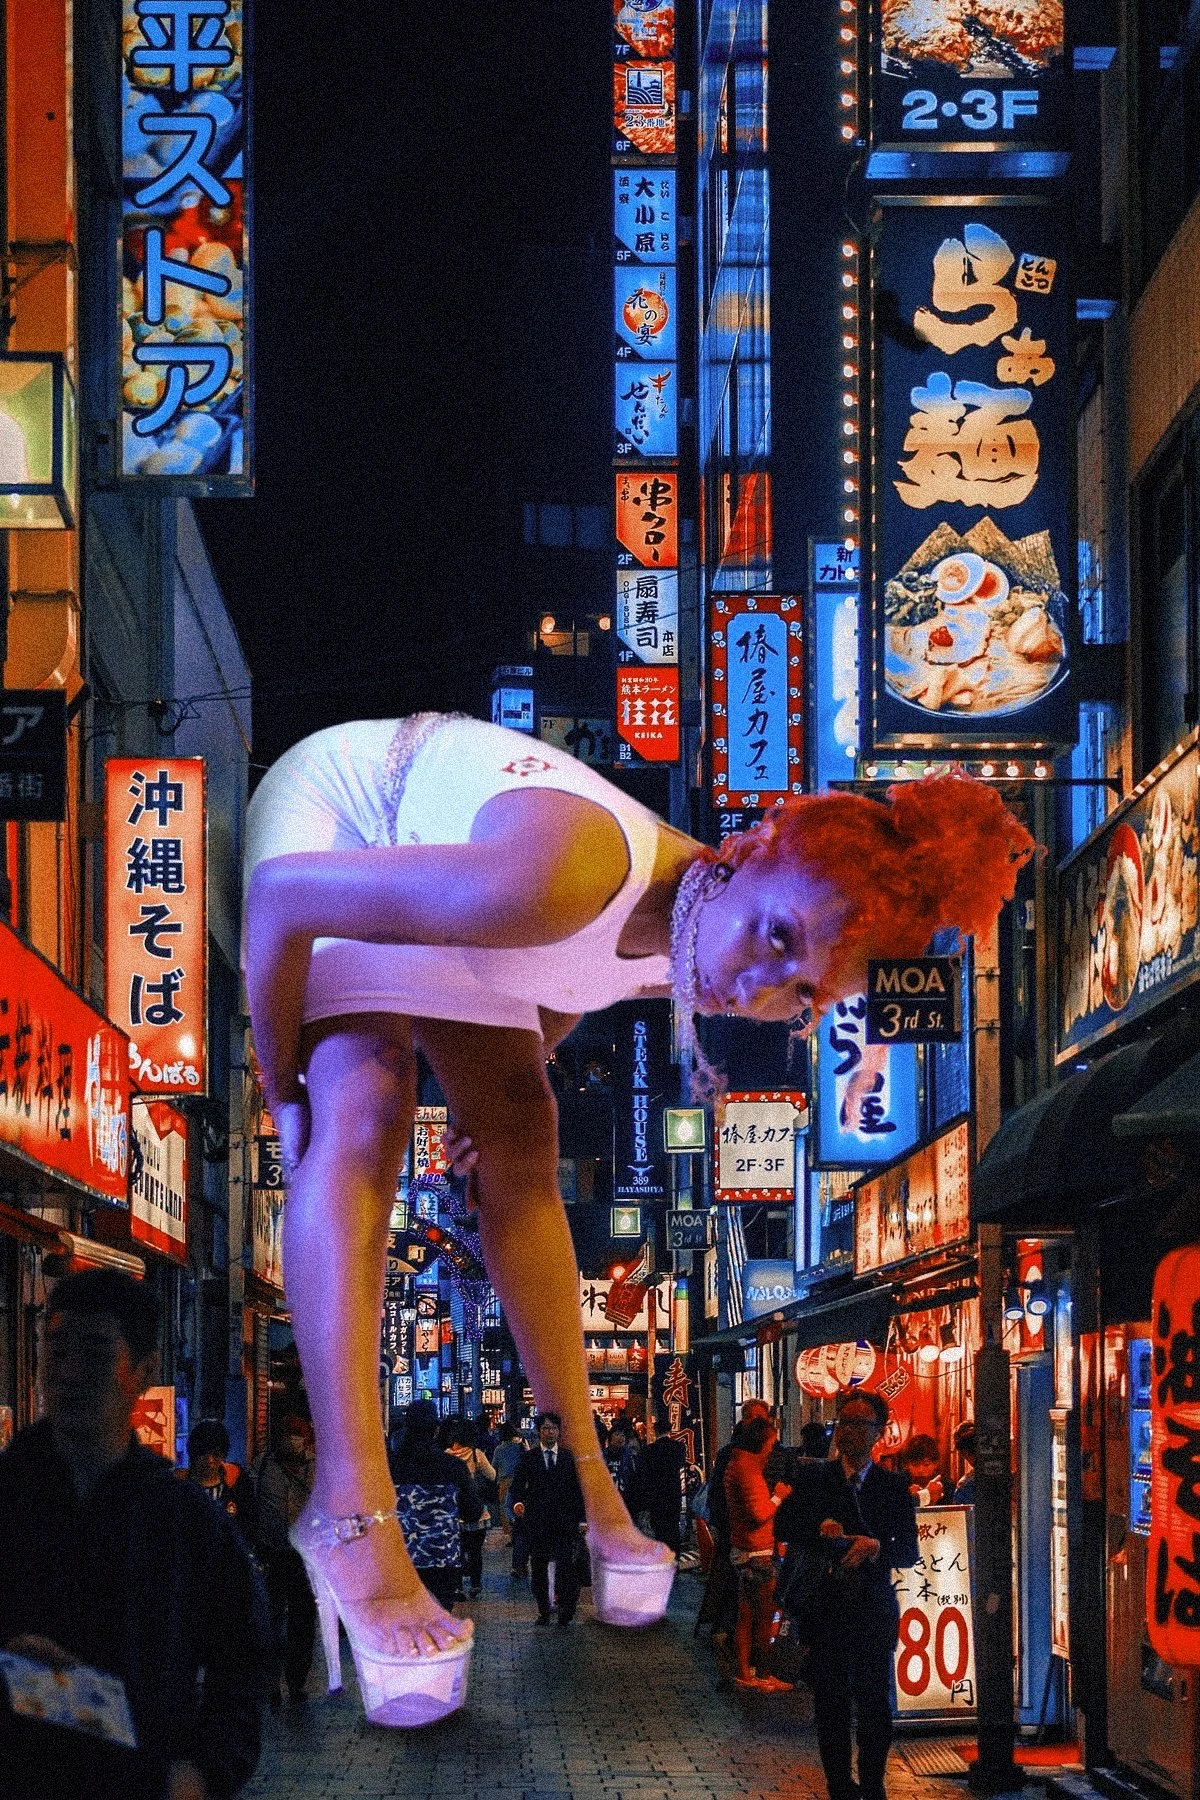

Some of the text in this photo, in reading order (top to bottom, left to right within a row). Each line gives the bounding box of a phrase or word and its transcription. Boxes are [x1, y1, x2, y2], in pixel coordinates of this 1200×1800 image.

[615, 44, 631, 55] 7F
[616, 141, 631, 151] 6F
[132, 0, 234, 437] 平ストア
[634, 177, 656, 254] 大小原
[616, 251, 631, 261] 5F
[626, 288, 657, 346] 花の宴
[616, 347, 632, 358] 4F
[620, 381, 651, 445] せんだい
[617, 443, 632, 454] 3F
[617, 554, 633, 565] 2F
[635, 574, 659, 649] 扇寿司
[618, 651, 634, 662] 1F
[662, 630, 674, 657] 本店
[621, 685, 676, 701] 熊本ラーメン
[736, 624, 779, 781] 椿屋カフェ
[621, 698, 678, 726] 桂花
[634, 732, 664, 740] KEIKA
[720, 814, 743, 828] 2F
[128, 770, 186, 1026] 沖縄そば
[875, 967, 946, 994] MOA
[879, 1005, 919, 1037] 3rd
[632, 1021, 649, 1088] STEAK
[632, 1095, 648, 1162] HOUSE
[416, 1127, 430, 1168] お好み焼
[632, 1176, 649, 1186] 389
[671, 1215, 703, 1227] MOA
